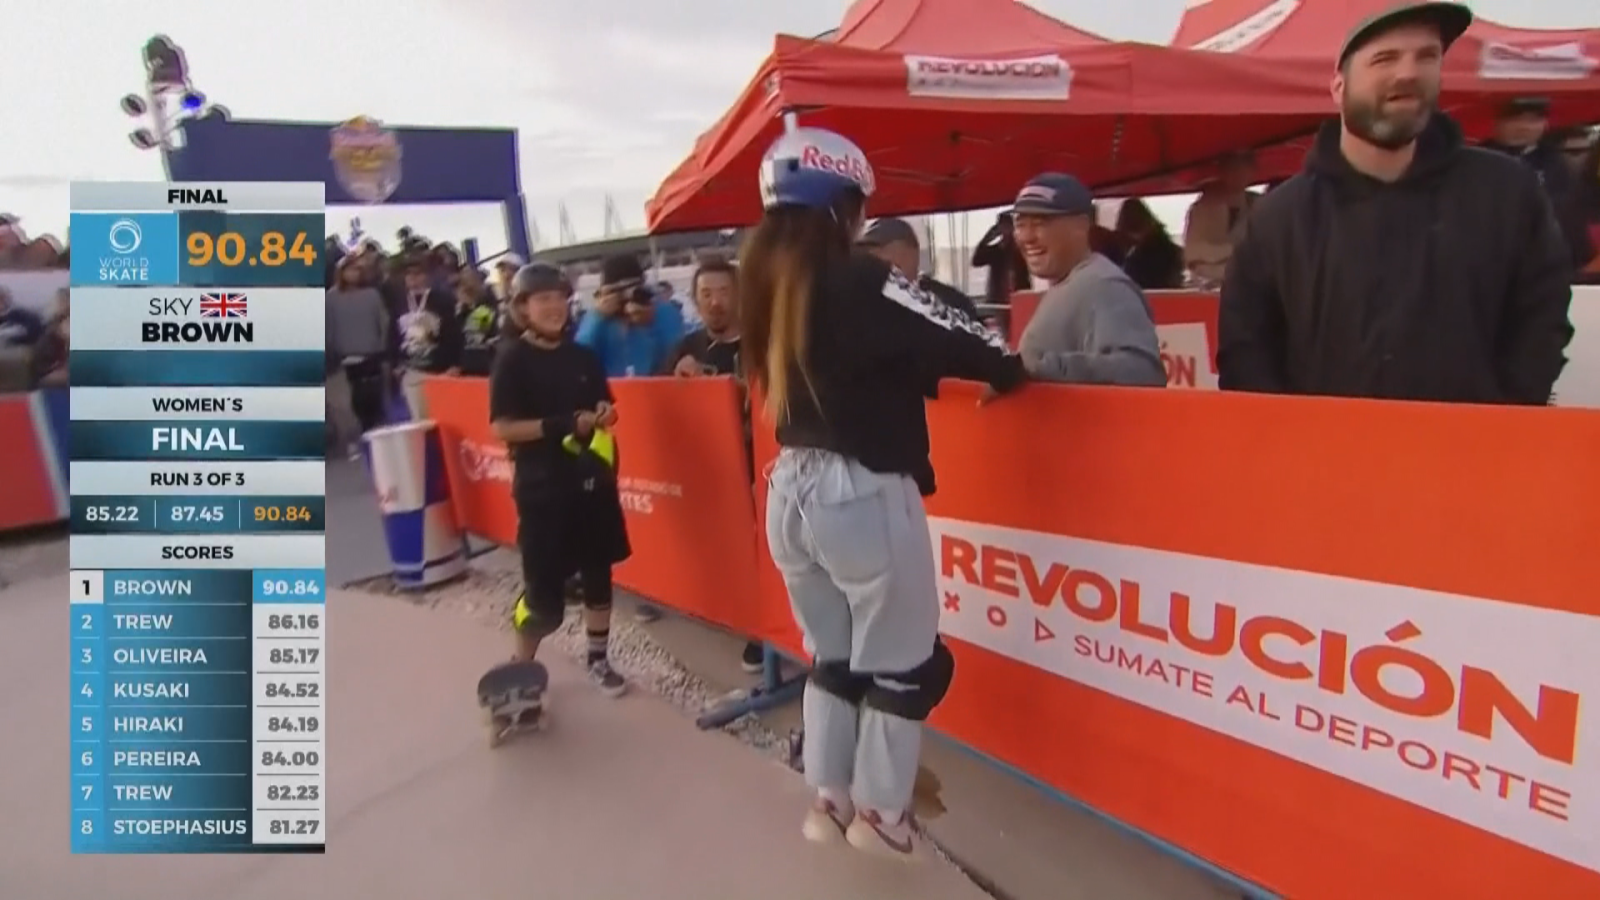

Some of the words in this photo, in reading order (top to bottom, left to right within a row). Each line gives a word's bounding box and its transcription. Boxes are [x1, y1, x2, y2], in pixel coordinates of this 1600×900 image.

[941, 534, 1580, 765] REVOLUCIÓN
[1073, 634, 1214, 698] SUMATE
[1226, 684, 1281, 721] AL
[1294, 705, 1572, 821] DEPORTE
